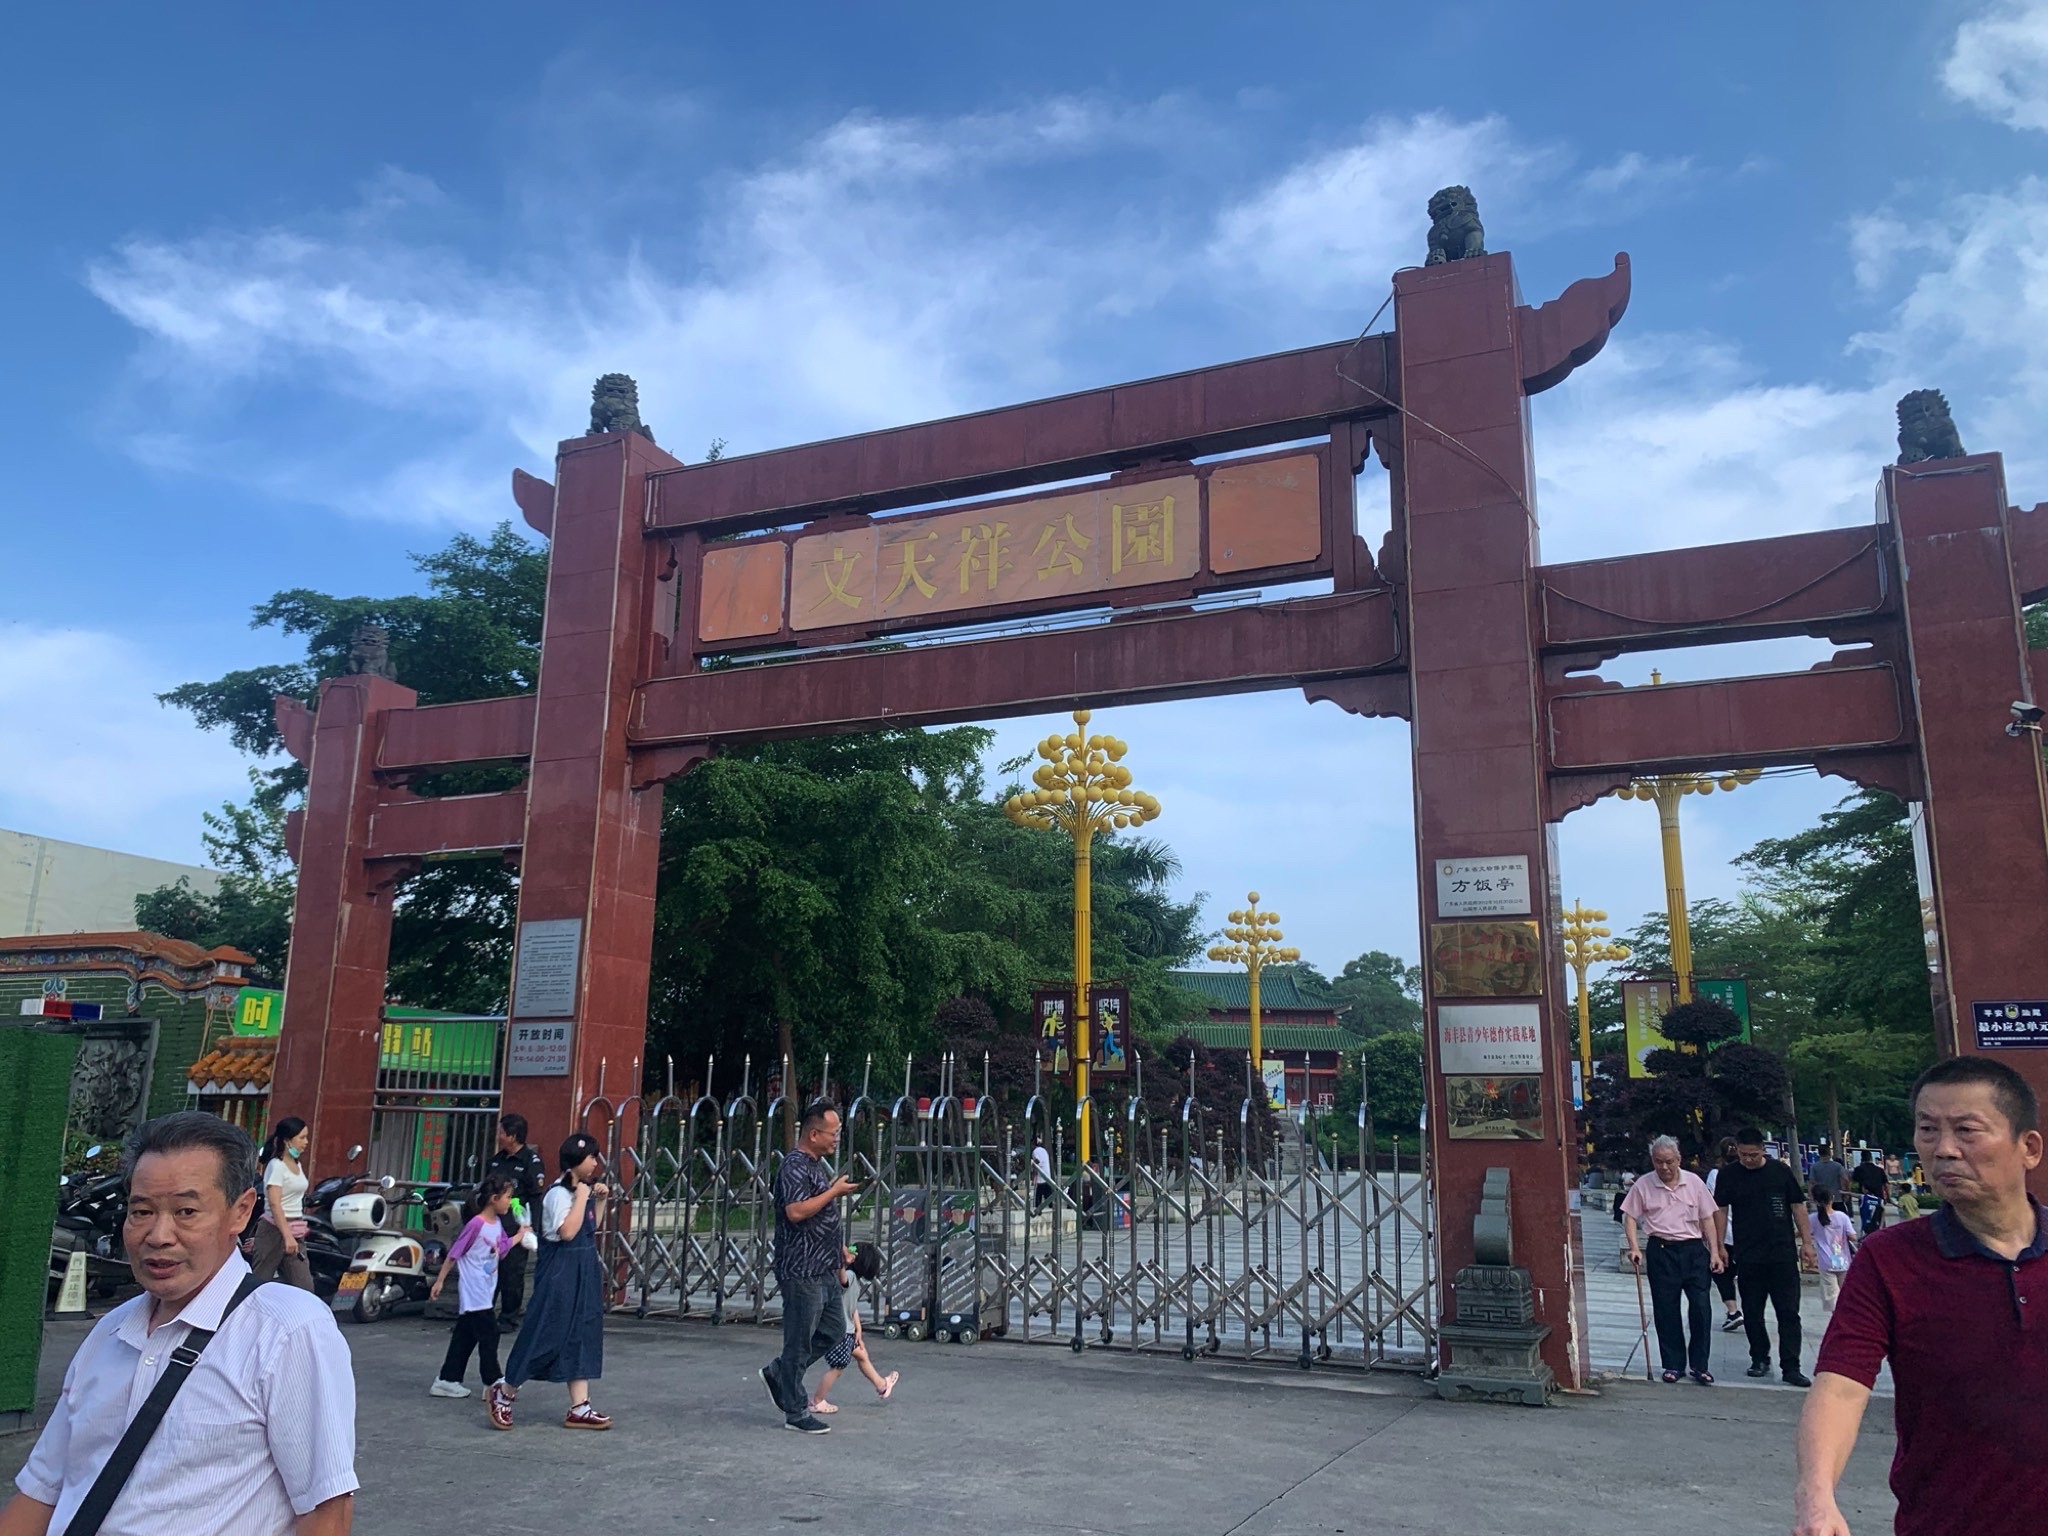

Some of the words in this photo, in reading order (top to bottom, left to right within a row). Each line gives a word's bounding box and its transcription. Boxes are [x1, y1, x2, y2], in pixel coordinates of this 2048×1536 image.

[808, 495, 1176, 613] 文天祥公園
[1451, 877, 1514, 893] 方饭亭
[1978, 1021, 2048, 1032] 最小应急单元
[518, 1028, 565, 1041] 开放时间
